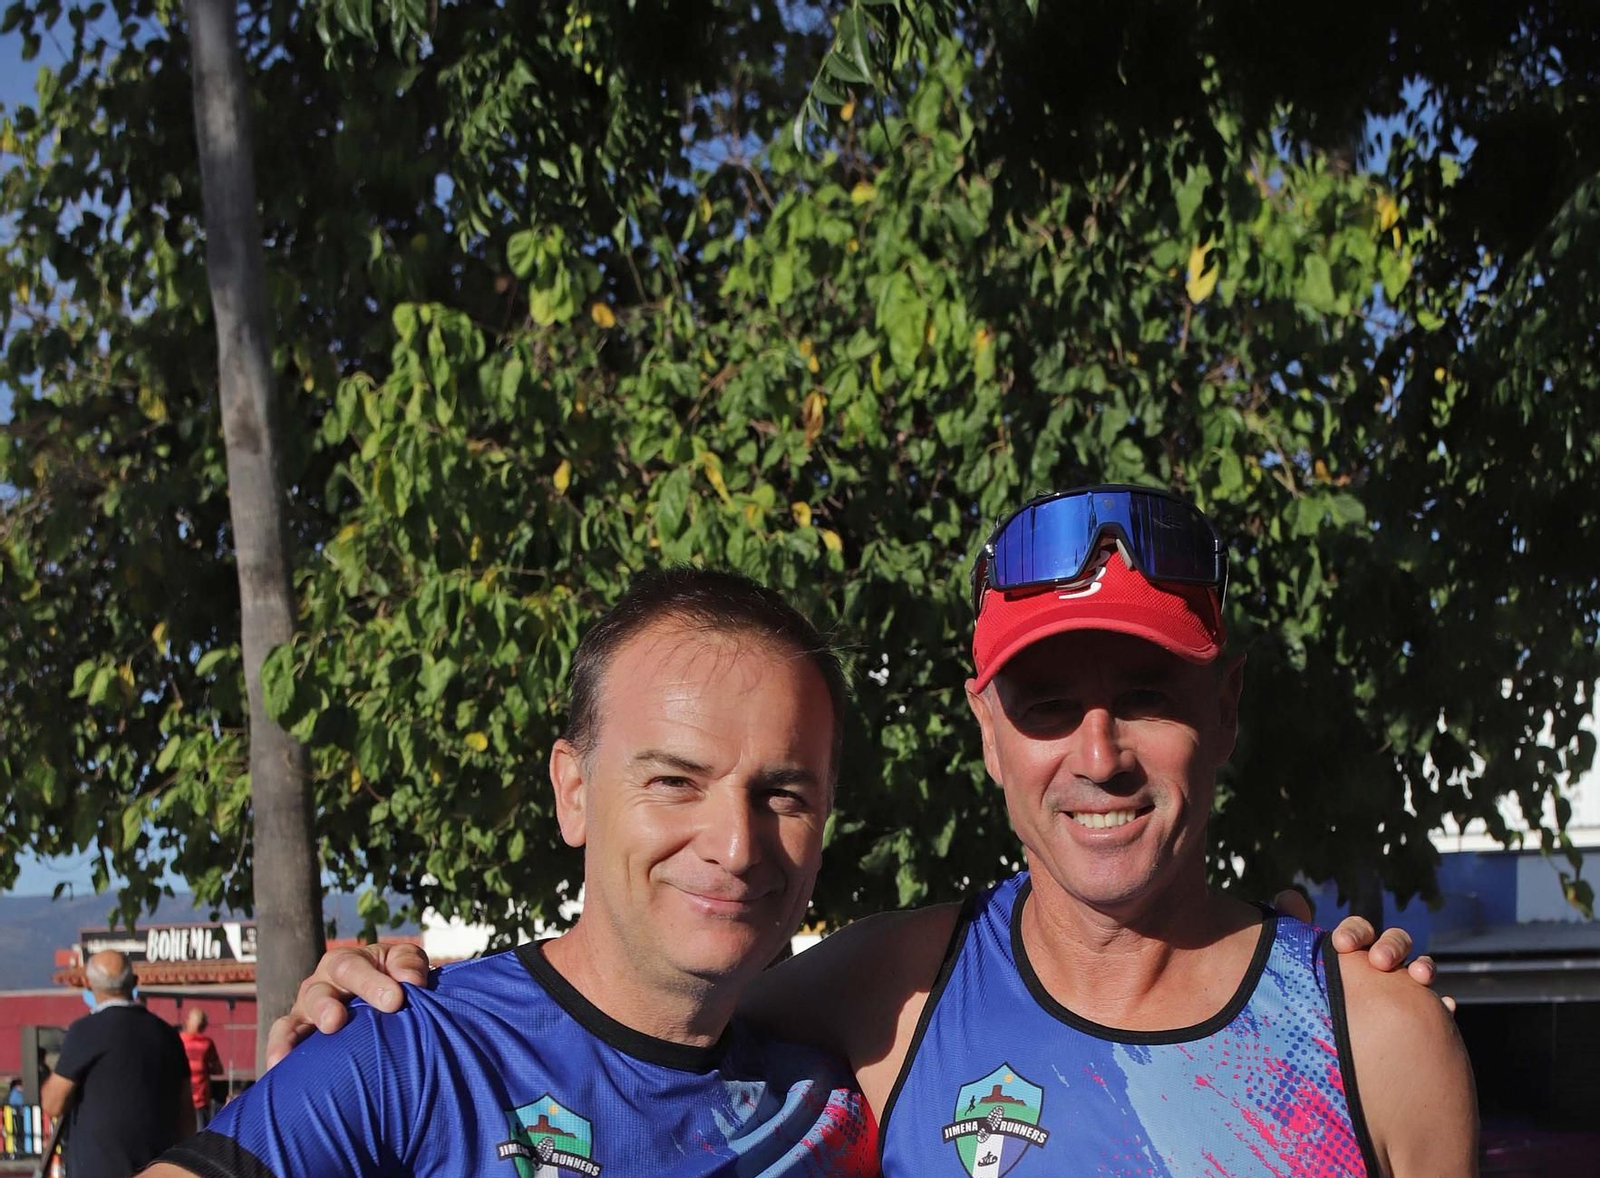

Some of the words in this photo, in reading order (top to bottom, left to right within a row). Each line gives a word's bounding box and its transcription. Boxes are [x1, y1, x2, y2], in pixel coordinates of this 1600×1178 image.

[944, 1121, 978, 1139] JIMENA
[999, 1121, 1047, 1143] RUNNERS
[552, 1153, 600, 1176] RUNNERS
